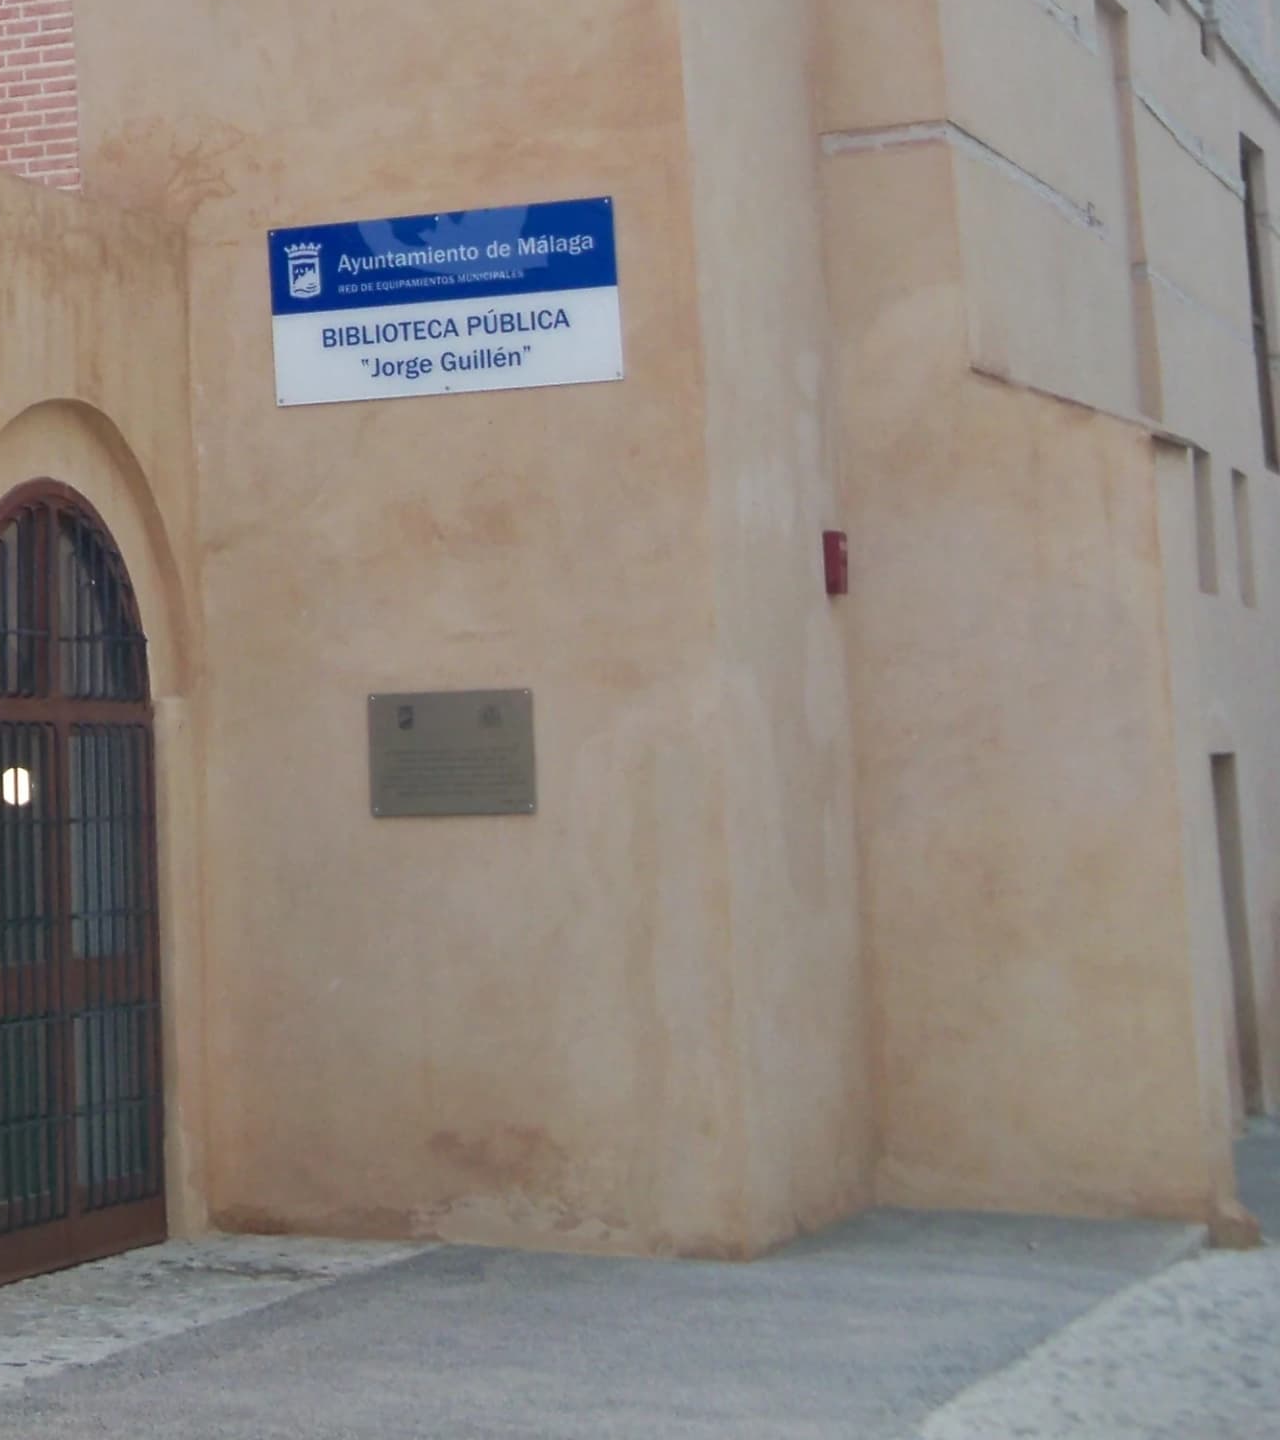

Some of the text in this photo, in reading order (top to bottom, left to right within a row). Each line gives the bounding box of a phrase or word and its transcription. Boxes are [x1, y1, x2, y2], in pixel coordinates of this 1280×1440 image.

[338, 234, 594, 275] Ayuntamiento de Málaga
[338, 270, 526, 294] RED DE EQUIPAMIENTOS MUNICIPALES
[322, 308, 571, 348] BIBLIOTECA PÚBLICA
